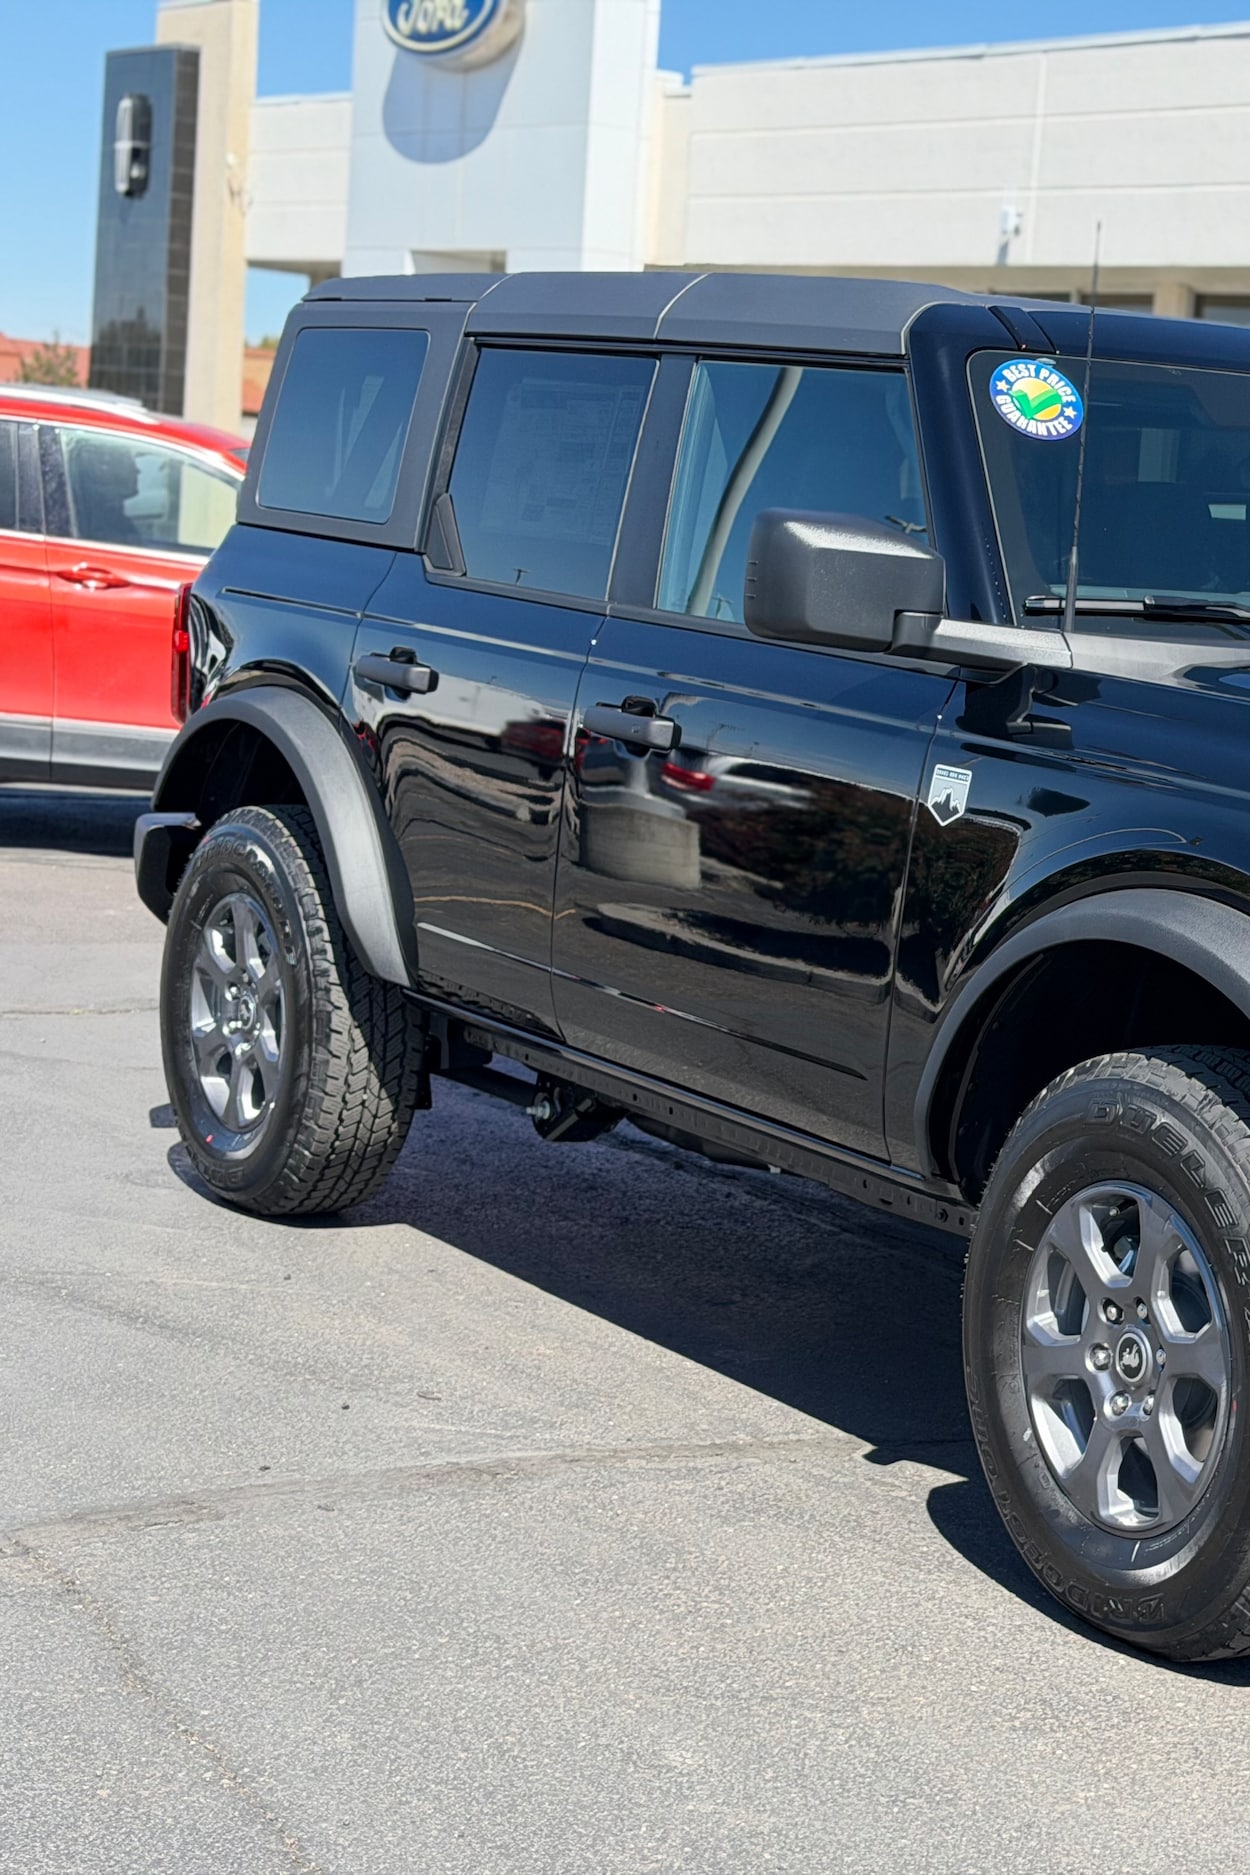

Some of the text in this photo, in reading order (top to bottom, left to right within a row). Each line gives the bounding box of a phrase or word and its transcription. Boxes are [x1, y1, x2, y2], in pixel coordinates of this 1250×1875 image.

[1001, 363, 1077, 403] BEST PRICE
[995, 394, 1073, 437] GUARANTEE
